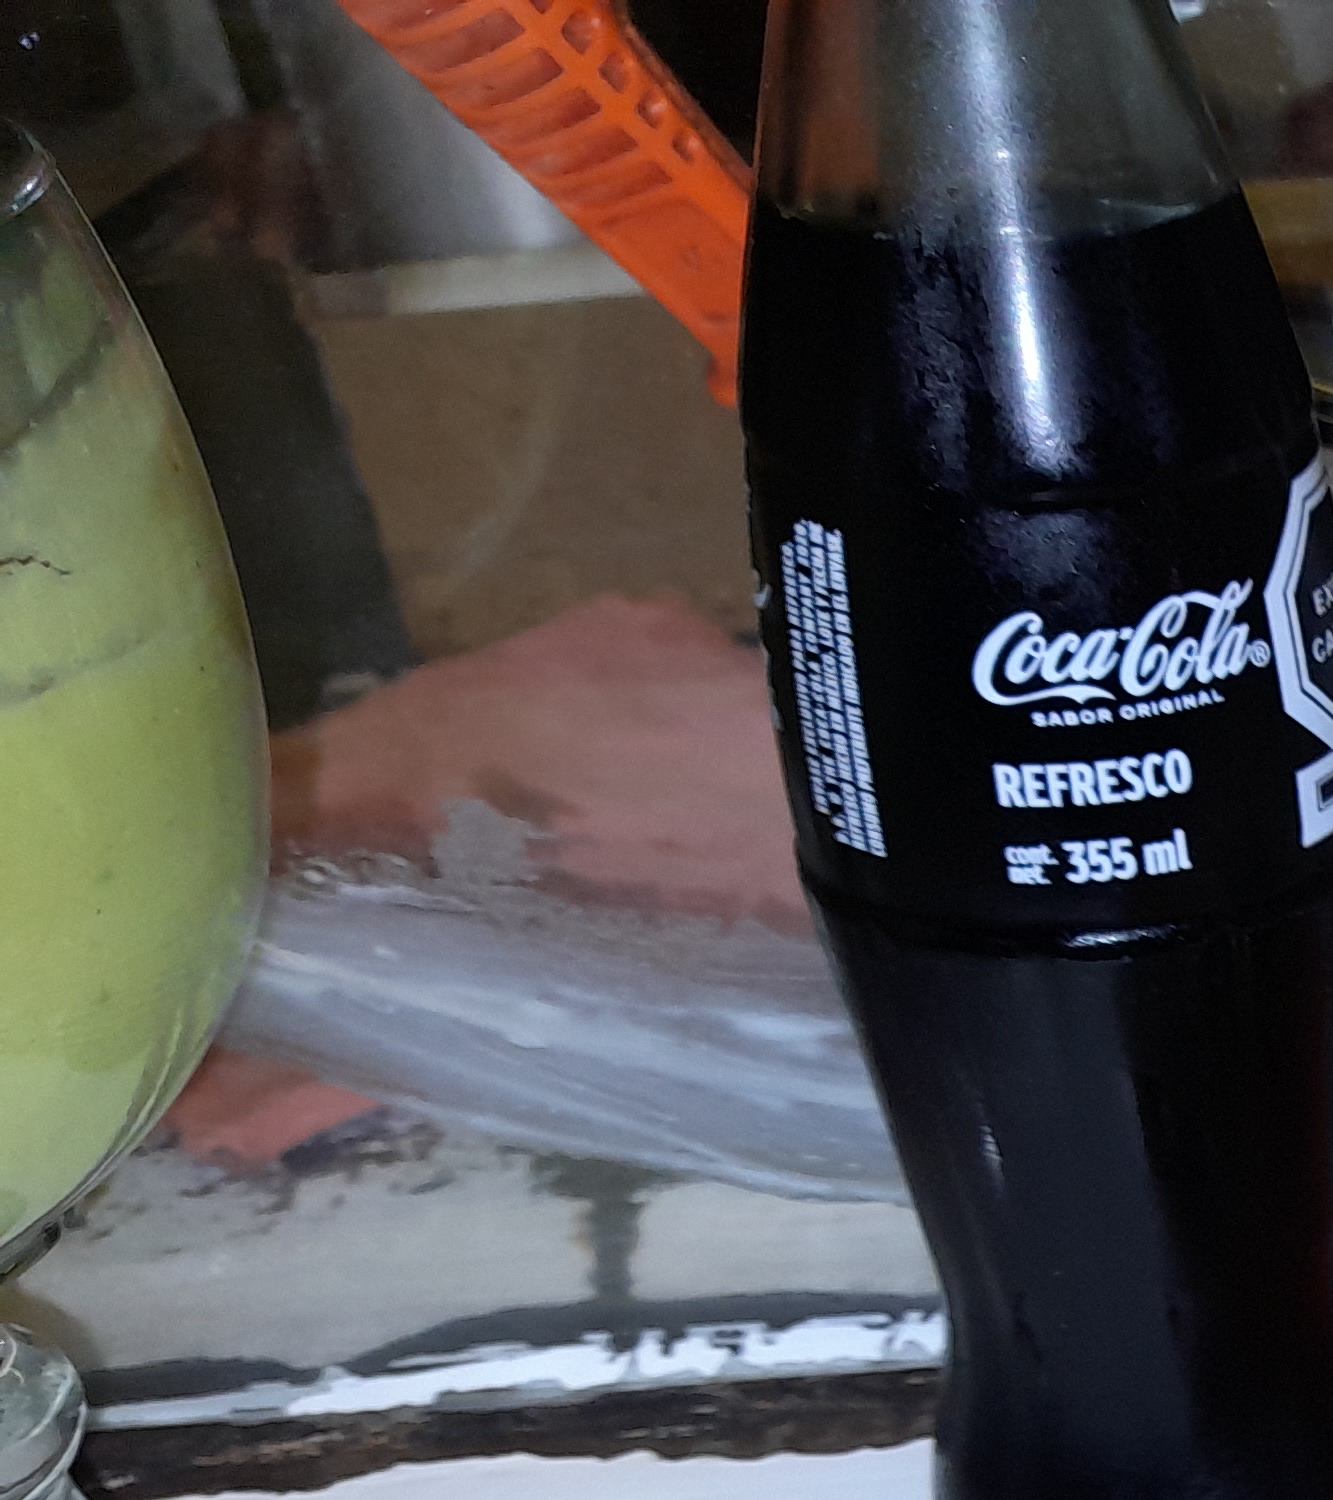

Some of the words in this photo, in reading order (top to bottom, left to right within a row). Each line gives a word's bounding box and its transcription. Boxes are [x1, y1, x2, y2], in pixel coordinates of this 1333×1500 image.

[1030, 706, 1114, 728] SABOR
[1118, 687, 1226, 722] ORIGINAL
[992, 748, 1193, 808] REFRESCO
[1061, 836, 1138, 884] 355
[1141, 827, 1194, 876] ml
